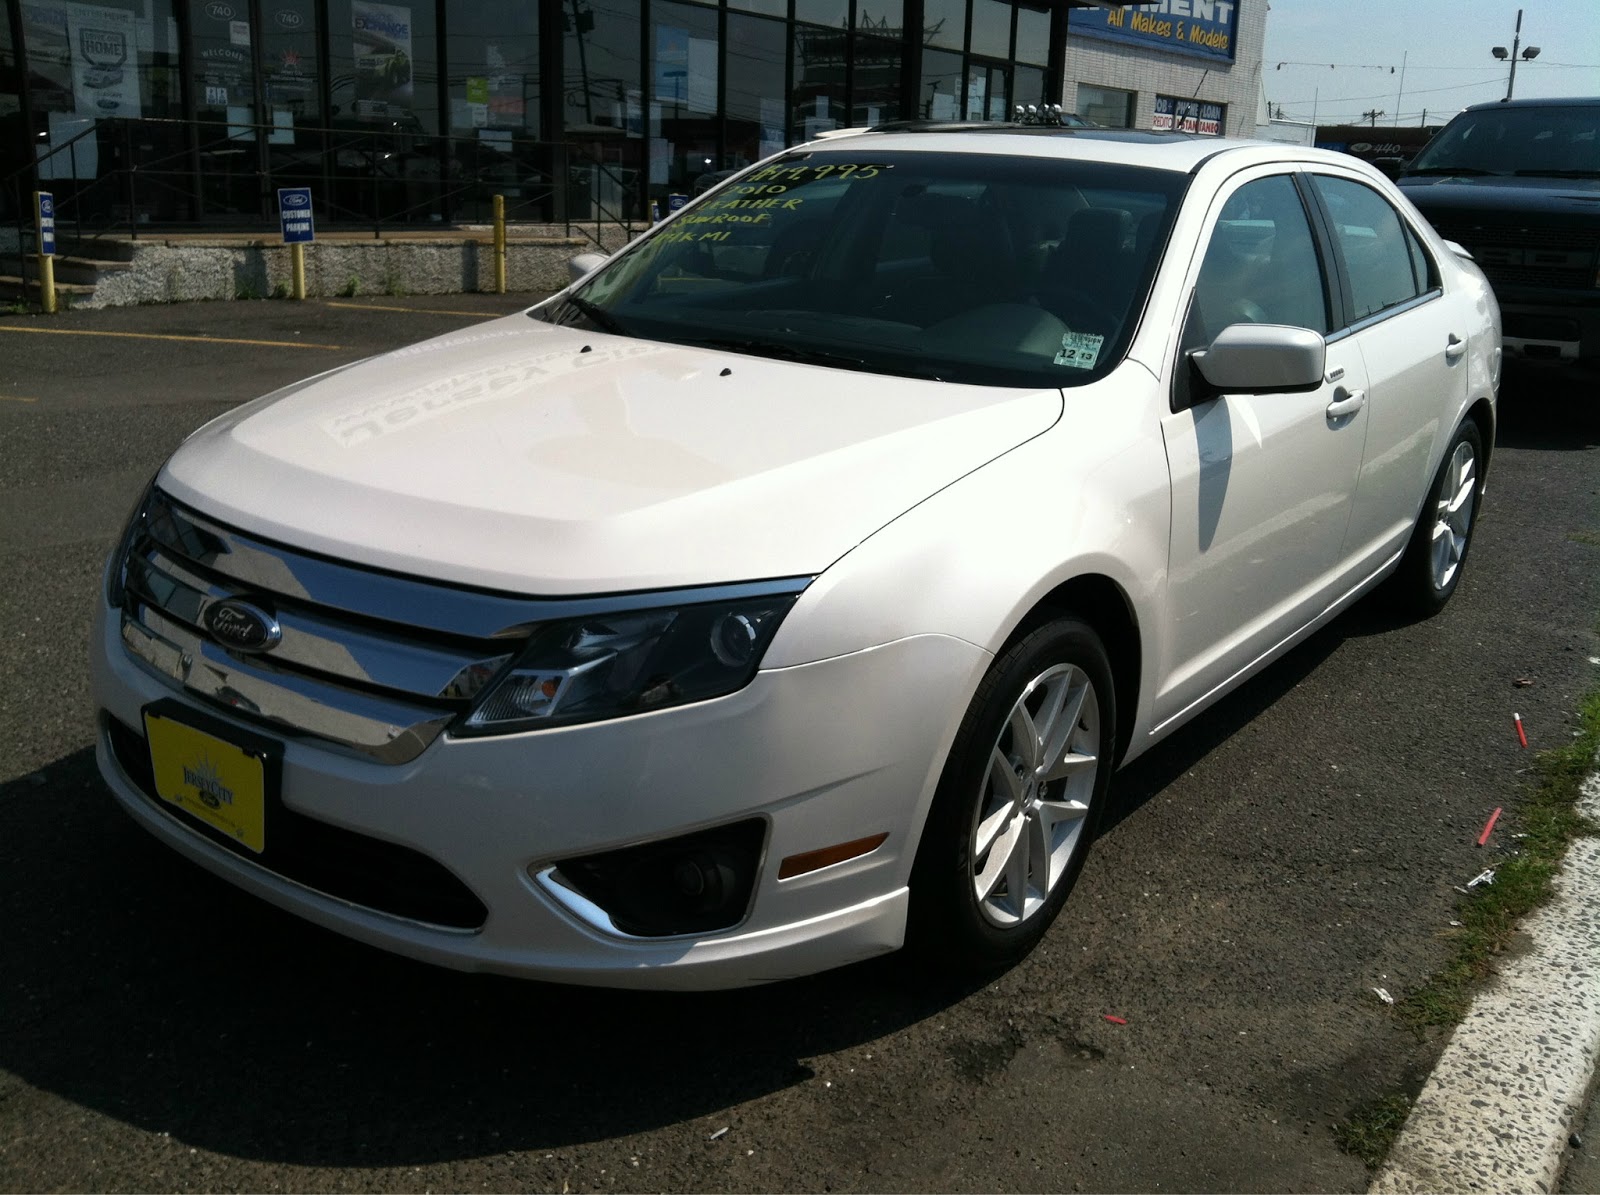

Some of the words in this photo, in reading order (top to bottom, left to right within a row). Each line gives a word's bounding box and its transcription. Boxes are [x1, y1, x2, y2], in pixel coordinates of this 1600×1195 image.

[211, 5, 232, 17] 740
[281, 13, 300, 24] 740
[1107, 8, 1126, 26] All
[1131, 12, 1172, 38] Makes
[1176, 21, 1185, 40] &
[1189, 25, 1229, 49] Models
[84, 40, 122, 56] HOME
[201, 48, 244, 61] WELCOME
[1373, 142, 1401, 154] 440
[721, 184, 787, 196] 2010
[697, 198, 804, 211] LEATHER
[671, 213, 772, 228] SUNROOF
[697, 231, 732, 242] MI
[1060, 348, 1076, 359] 12
[1080, 352, 1093, 361] 13
[213, 607, 254, 638] Ford
